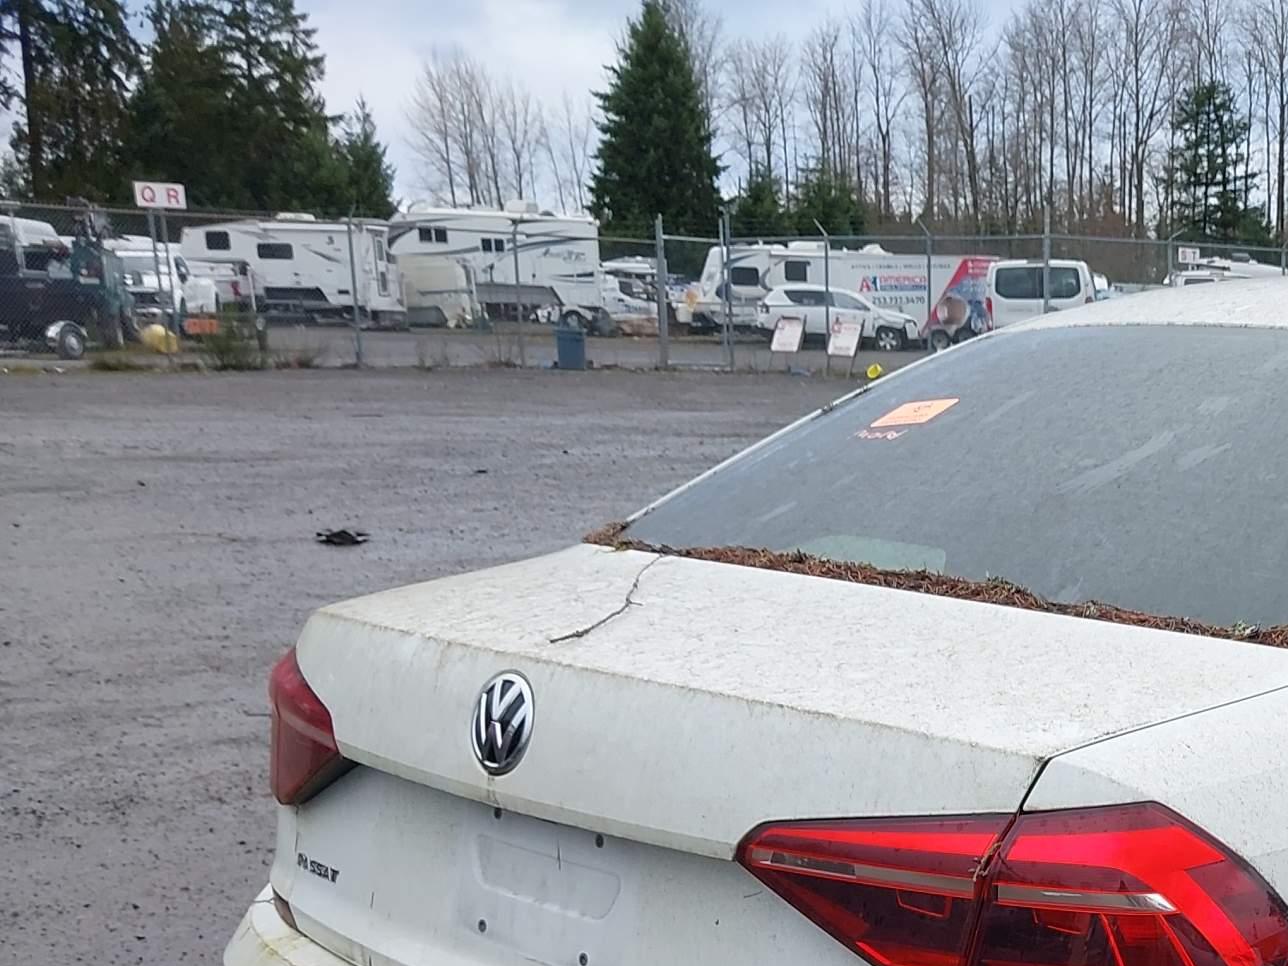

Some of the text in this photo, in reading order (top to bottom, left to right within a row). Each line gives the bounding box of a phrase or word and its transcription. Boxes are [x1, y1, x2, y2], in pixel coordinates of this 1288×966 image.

[141, 185, 180, 205] Q R
[297, 852, 340, 883] PASSAT
